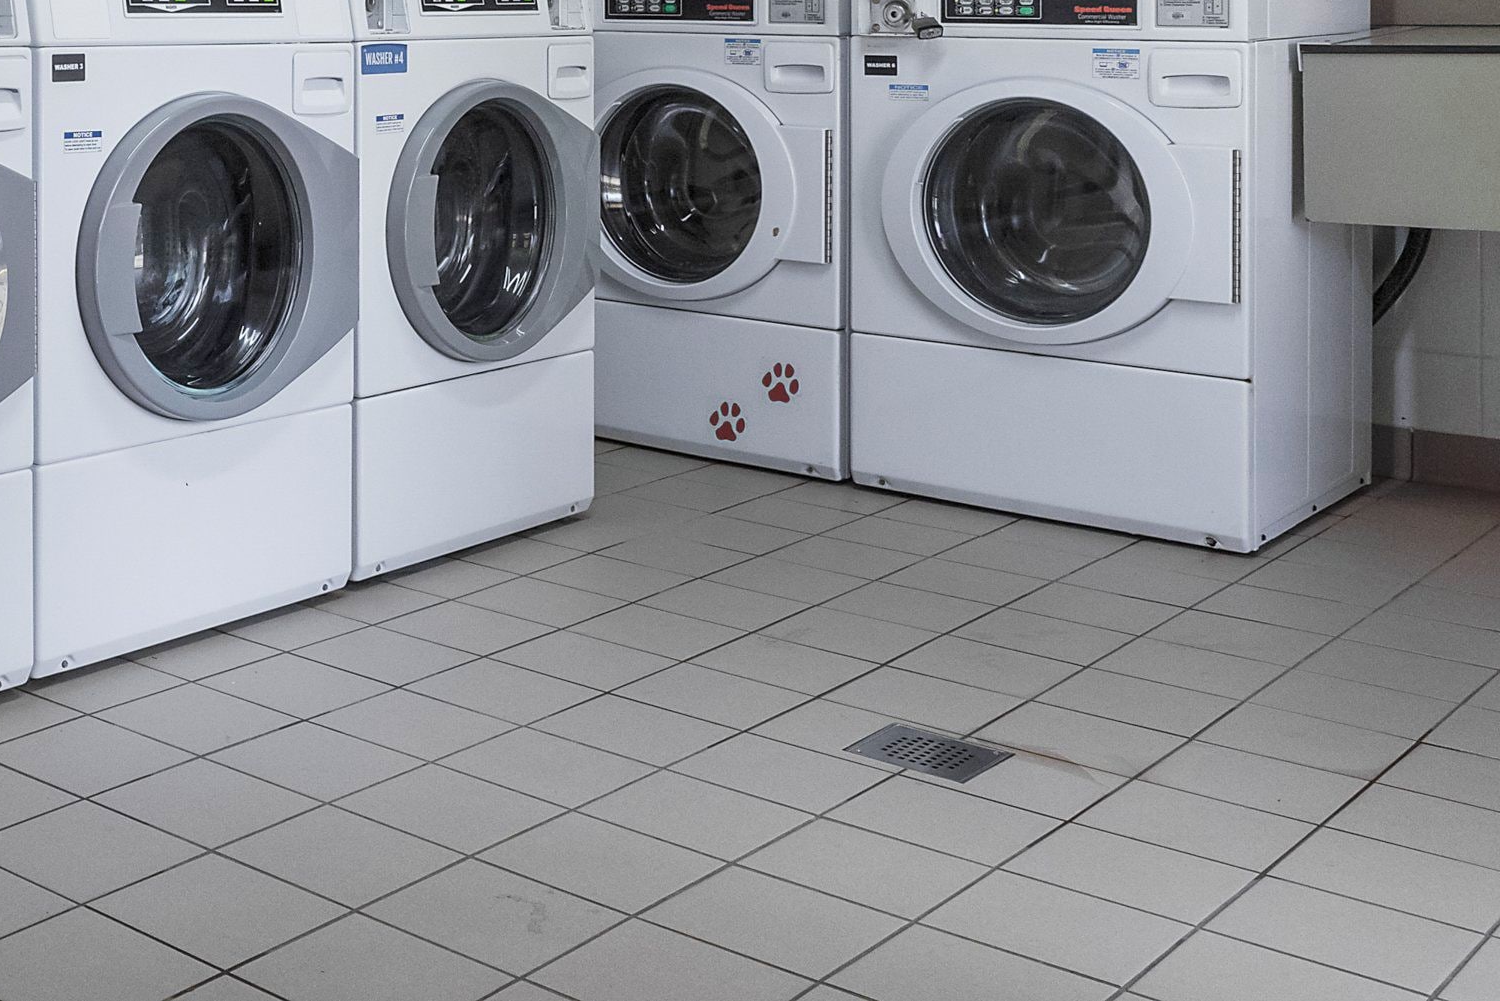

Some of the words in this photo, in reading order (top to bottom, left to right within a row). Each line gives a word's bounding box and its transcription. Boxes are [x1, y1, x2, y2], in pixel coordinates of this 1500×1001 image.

[1074, 6, 1102, 14] Speed
[365, 52, 393, 66] WASHER
[394, 51, 404, 64] #4
